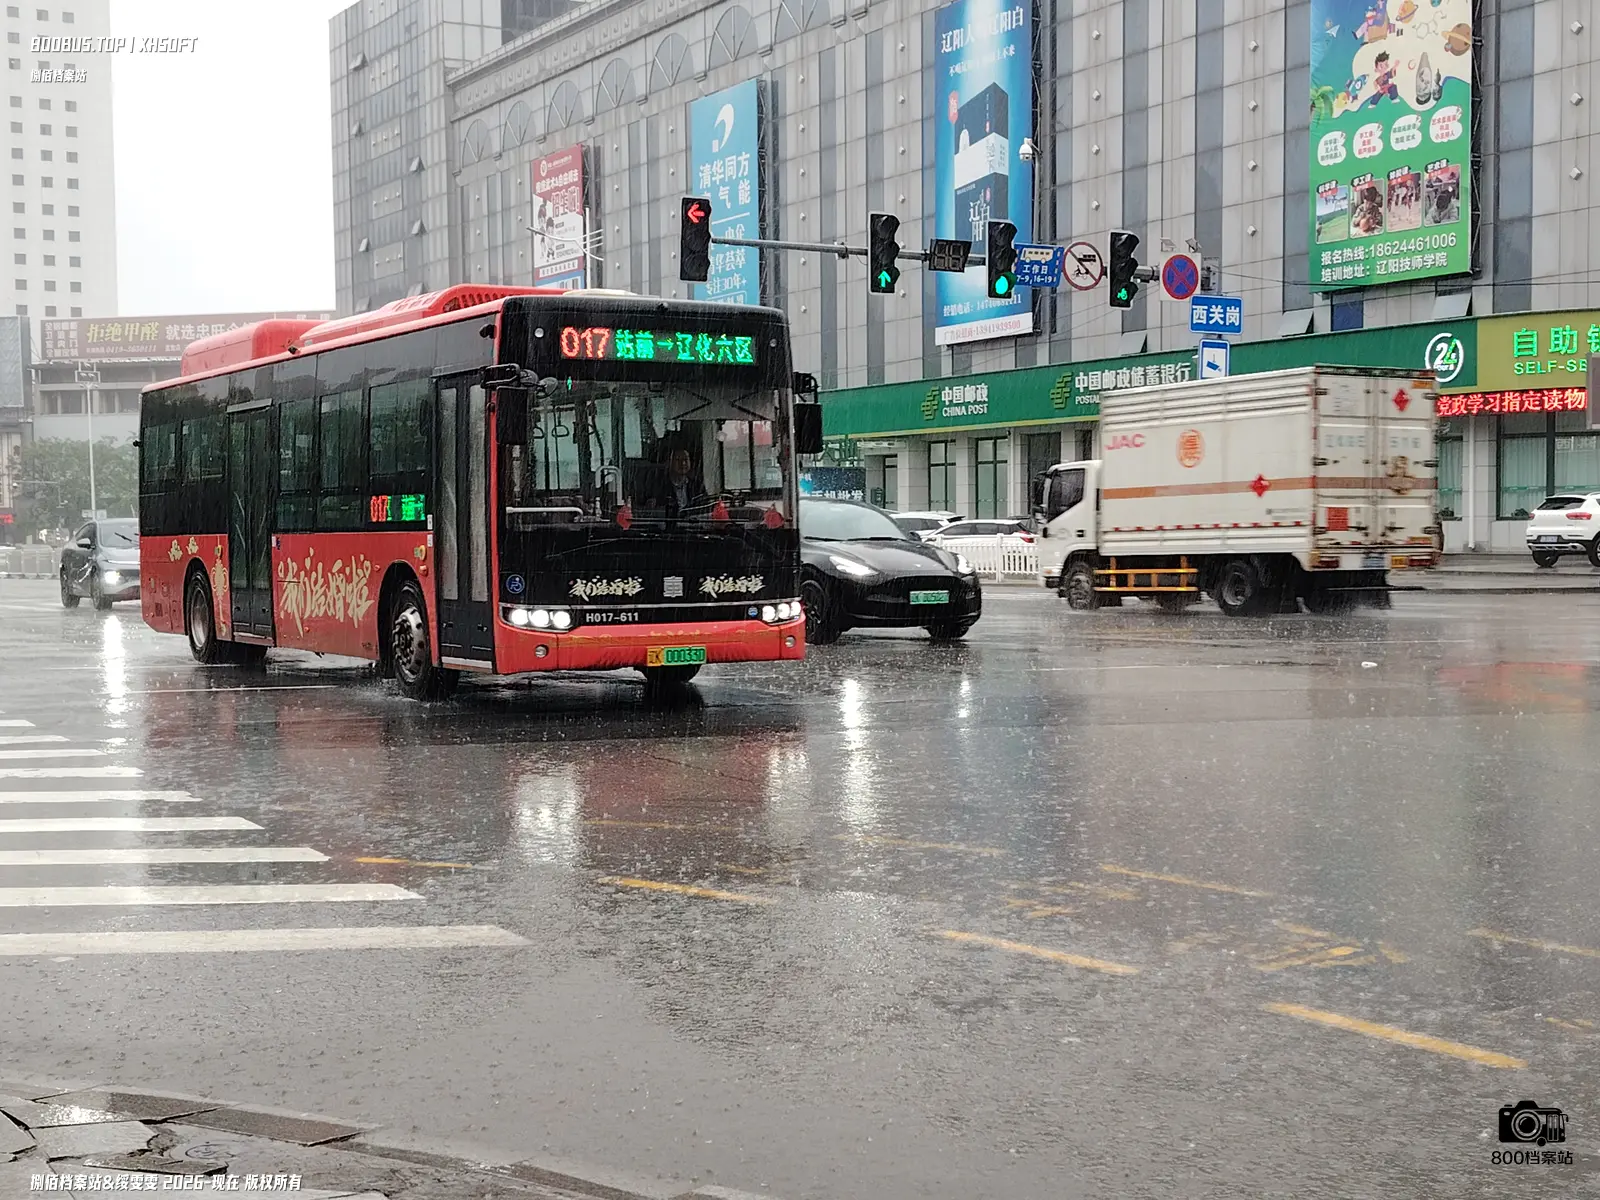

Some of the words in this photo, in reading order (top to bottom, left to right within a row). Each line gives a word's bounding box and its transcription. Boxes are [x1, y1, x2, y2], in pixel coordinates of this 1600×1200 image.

[699, 151, 750, 189] 清华同方
[1022, 264, 1048, 275] 工作日
[1192, 304, 1240, 326] 西关岗
[86, 321, 160, 343] 拒绝甲醛
[560, 326, 610, 359] 017
[1074, 362, 1191, 393] 中国邮政储蓄银行
[941, 382, 989, 405] 中国邮政
[1437, 388, 1586, 416] 党政学习指定读物
[942, 405, 966, 417] CHINA
[967, 403, 989, 415] POST
[1104, 433, 1146, 451] JAC
[585, 612, 639, 623] H017-611
